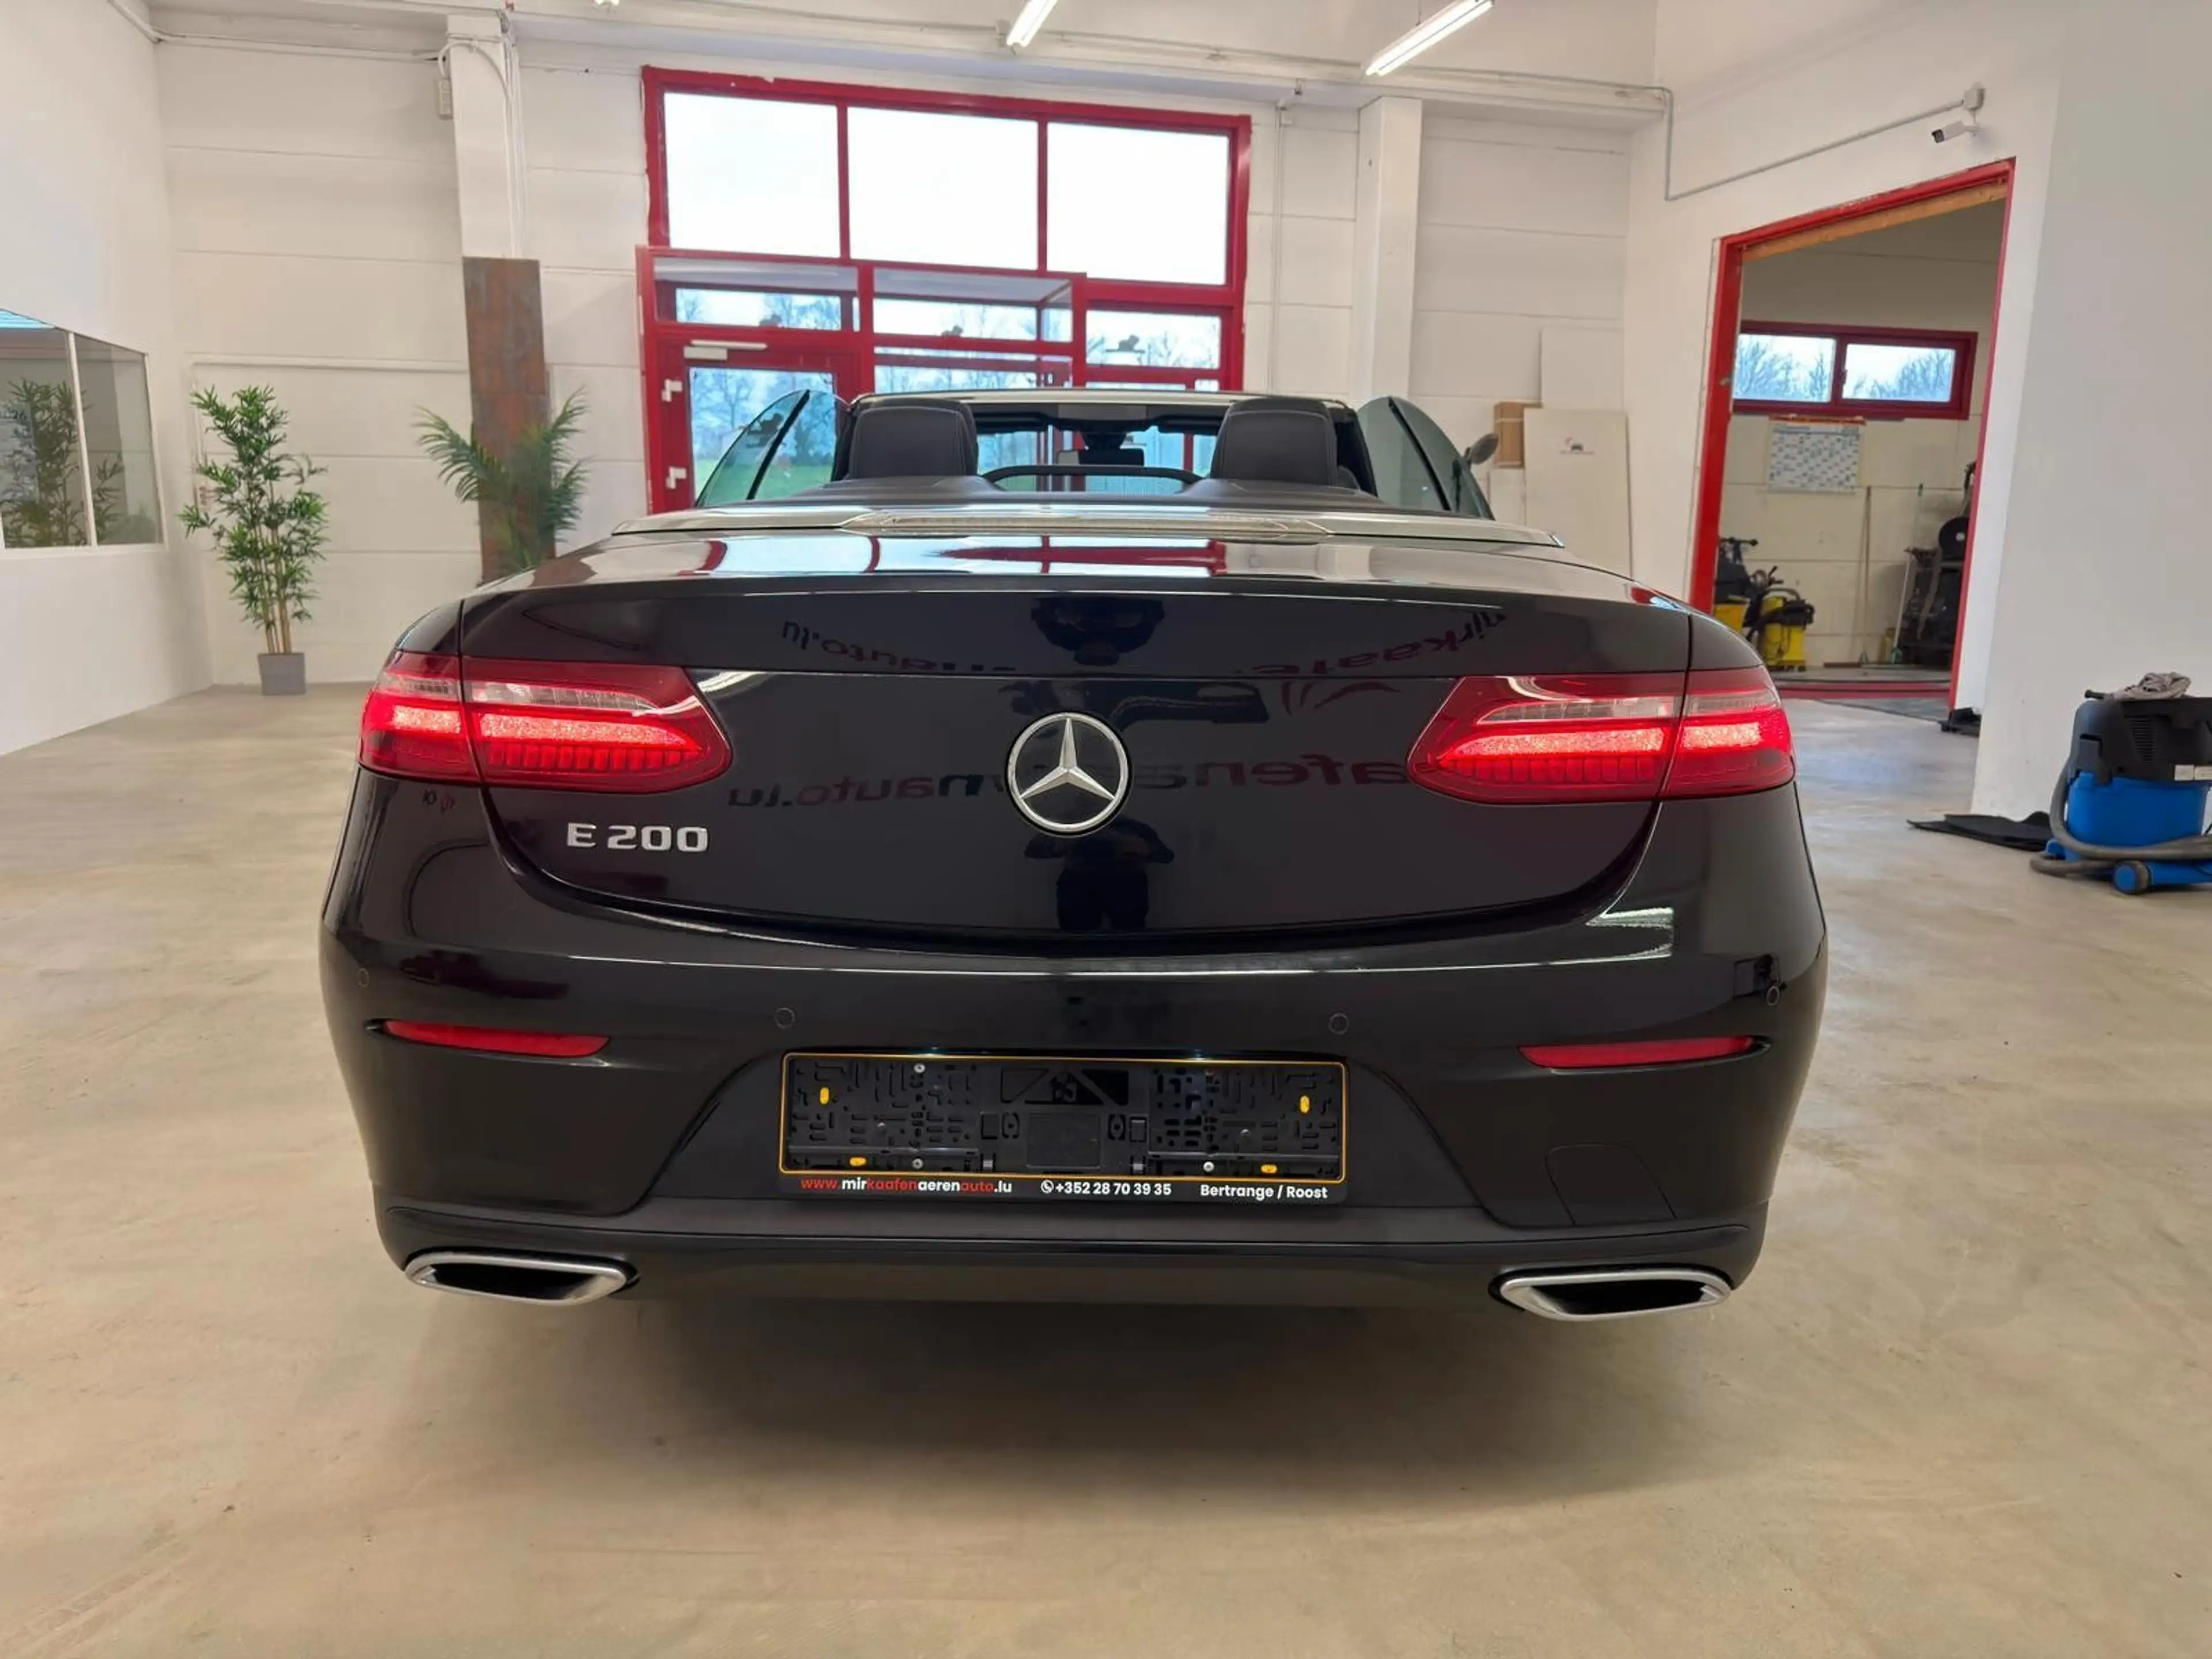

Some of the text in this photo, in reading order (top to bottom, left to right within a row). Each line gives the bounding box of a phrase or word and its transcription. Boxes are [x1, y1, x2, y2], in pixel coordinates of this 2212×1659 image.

[567, 823, 708, 852] E 200
[1055, 1181, 1172, 1196] +352 28 70 39 35
[1200, 1184, 1274, 1201] Bertrange
[1286, 1186, 1328, 1199] Roost
